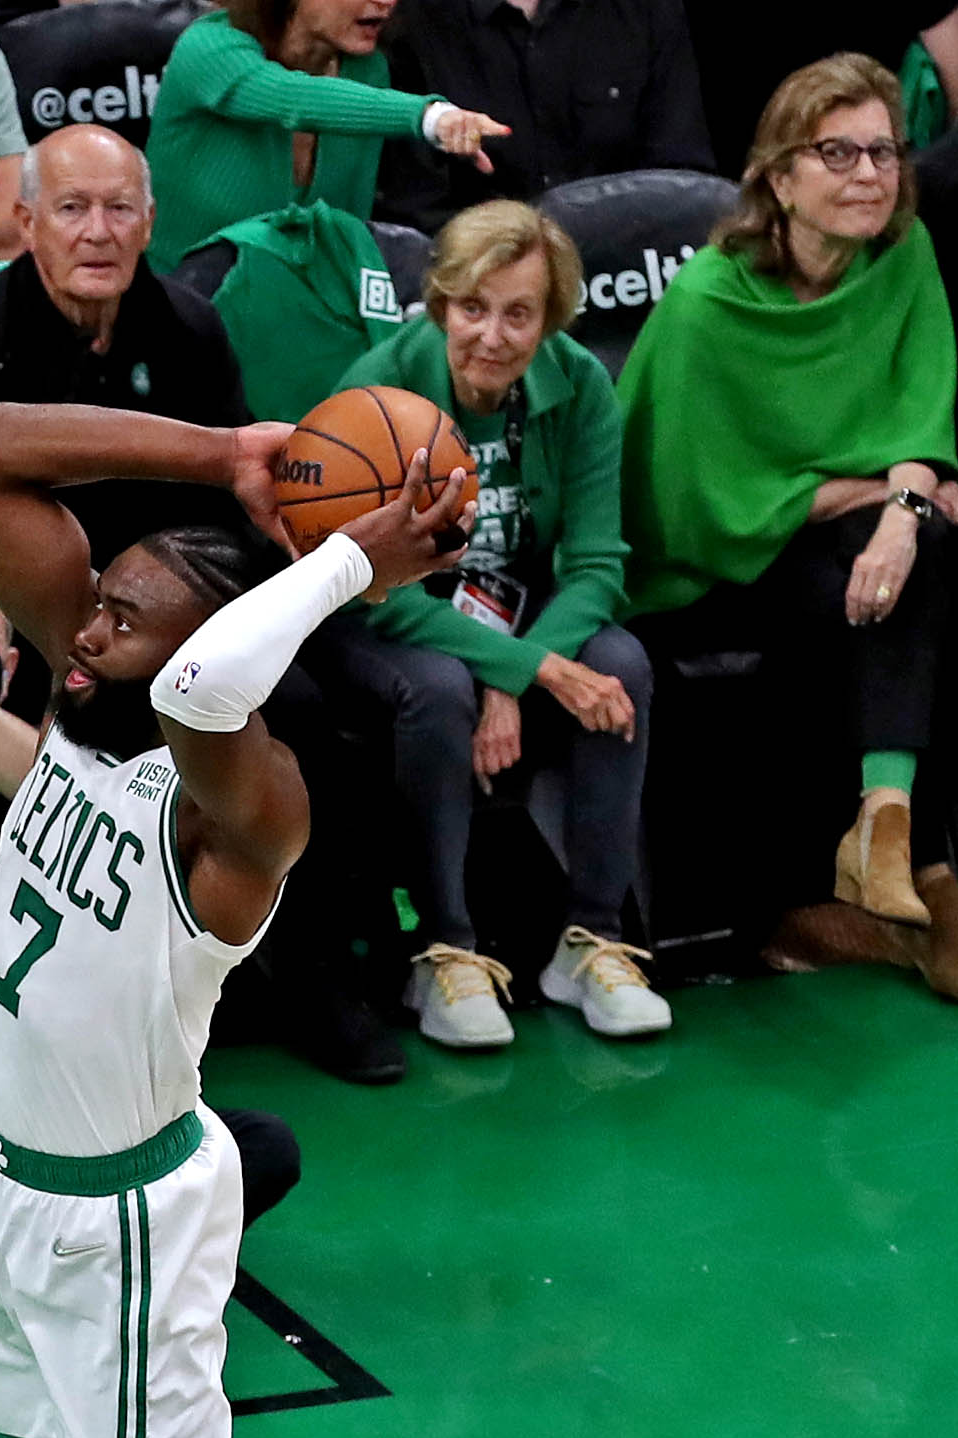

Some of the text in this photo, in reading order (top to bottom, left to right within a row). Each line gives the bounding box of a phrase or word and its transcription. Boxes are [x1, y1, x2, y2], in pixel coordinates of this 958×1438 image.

[32, 65, 167, 128] @celt
[574, 244, 695, 315] celt
[126, 780, 163, 802] PRINT
[135, 761, 172, 786] VISTA
